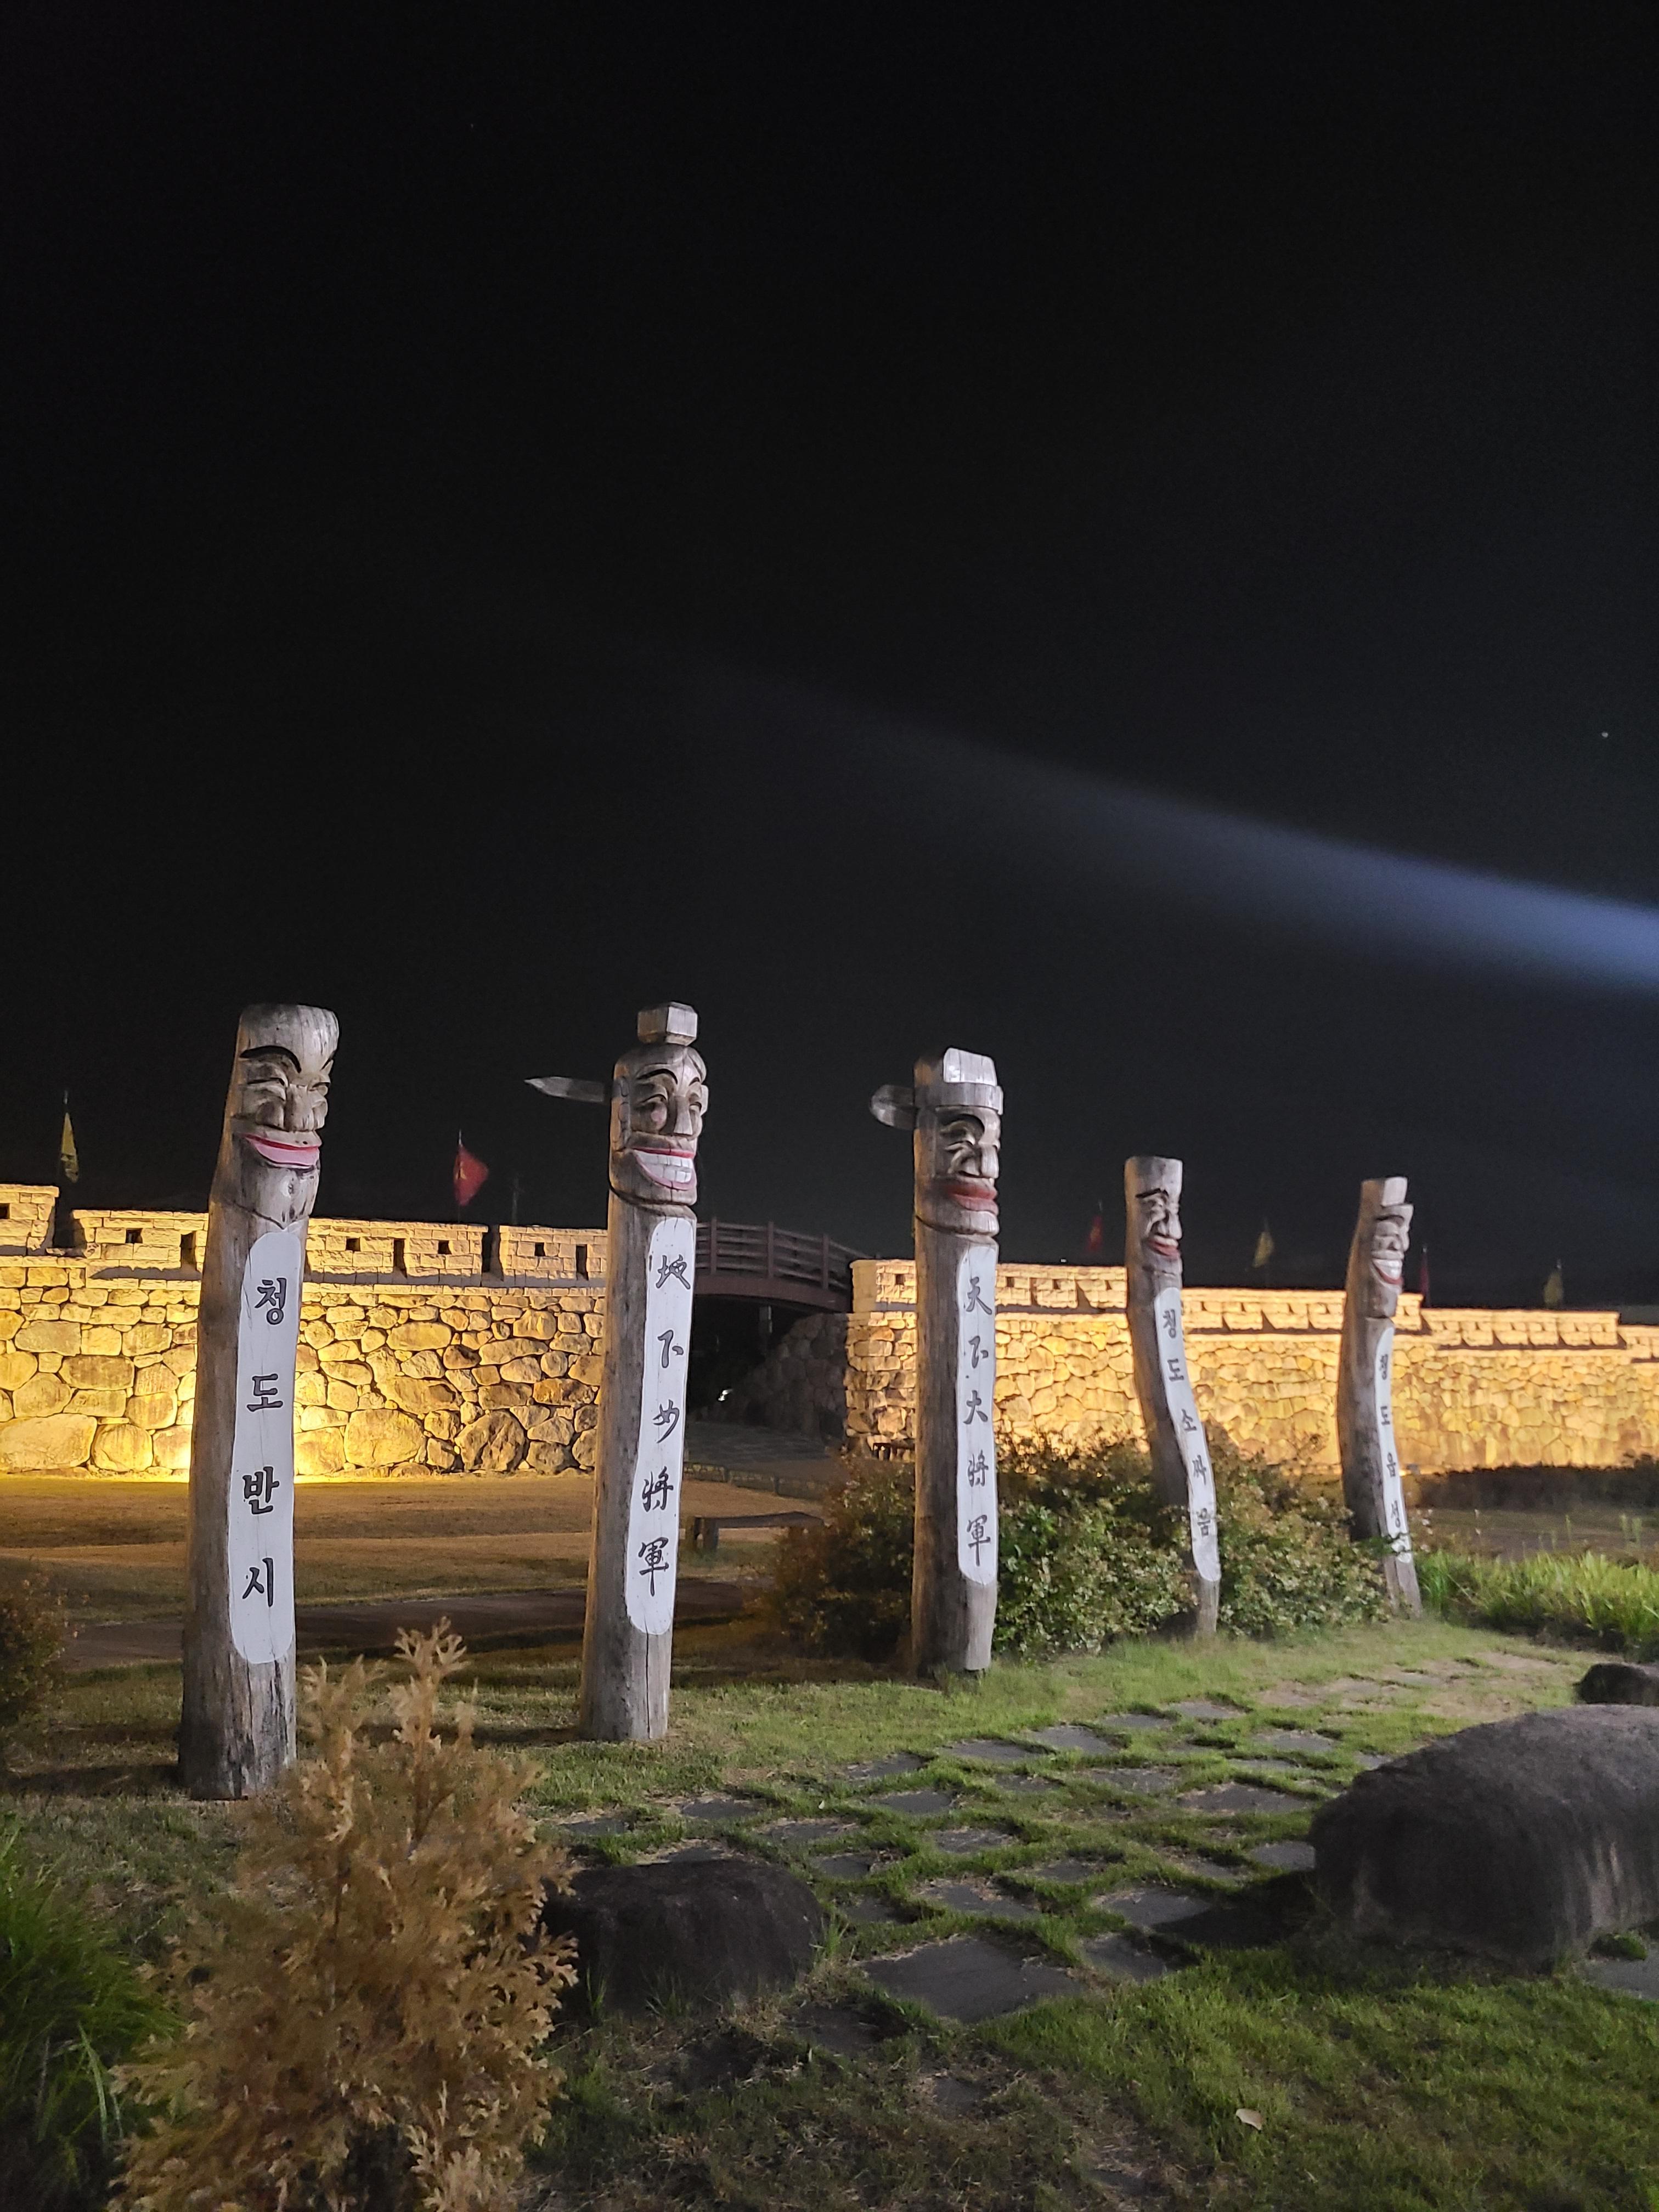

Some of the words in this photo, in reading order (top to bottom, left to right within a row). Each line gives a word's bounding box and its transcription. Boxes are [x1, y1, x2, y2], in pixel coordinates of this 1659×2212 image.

[242, 1277, 287, 1608] 청도반시
[963, 1276, 992, 1566] 天下大將軍
